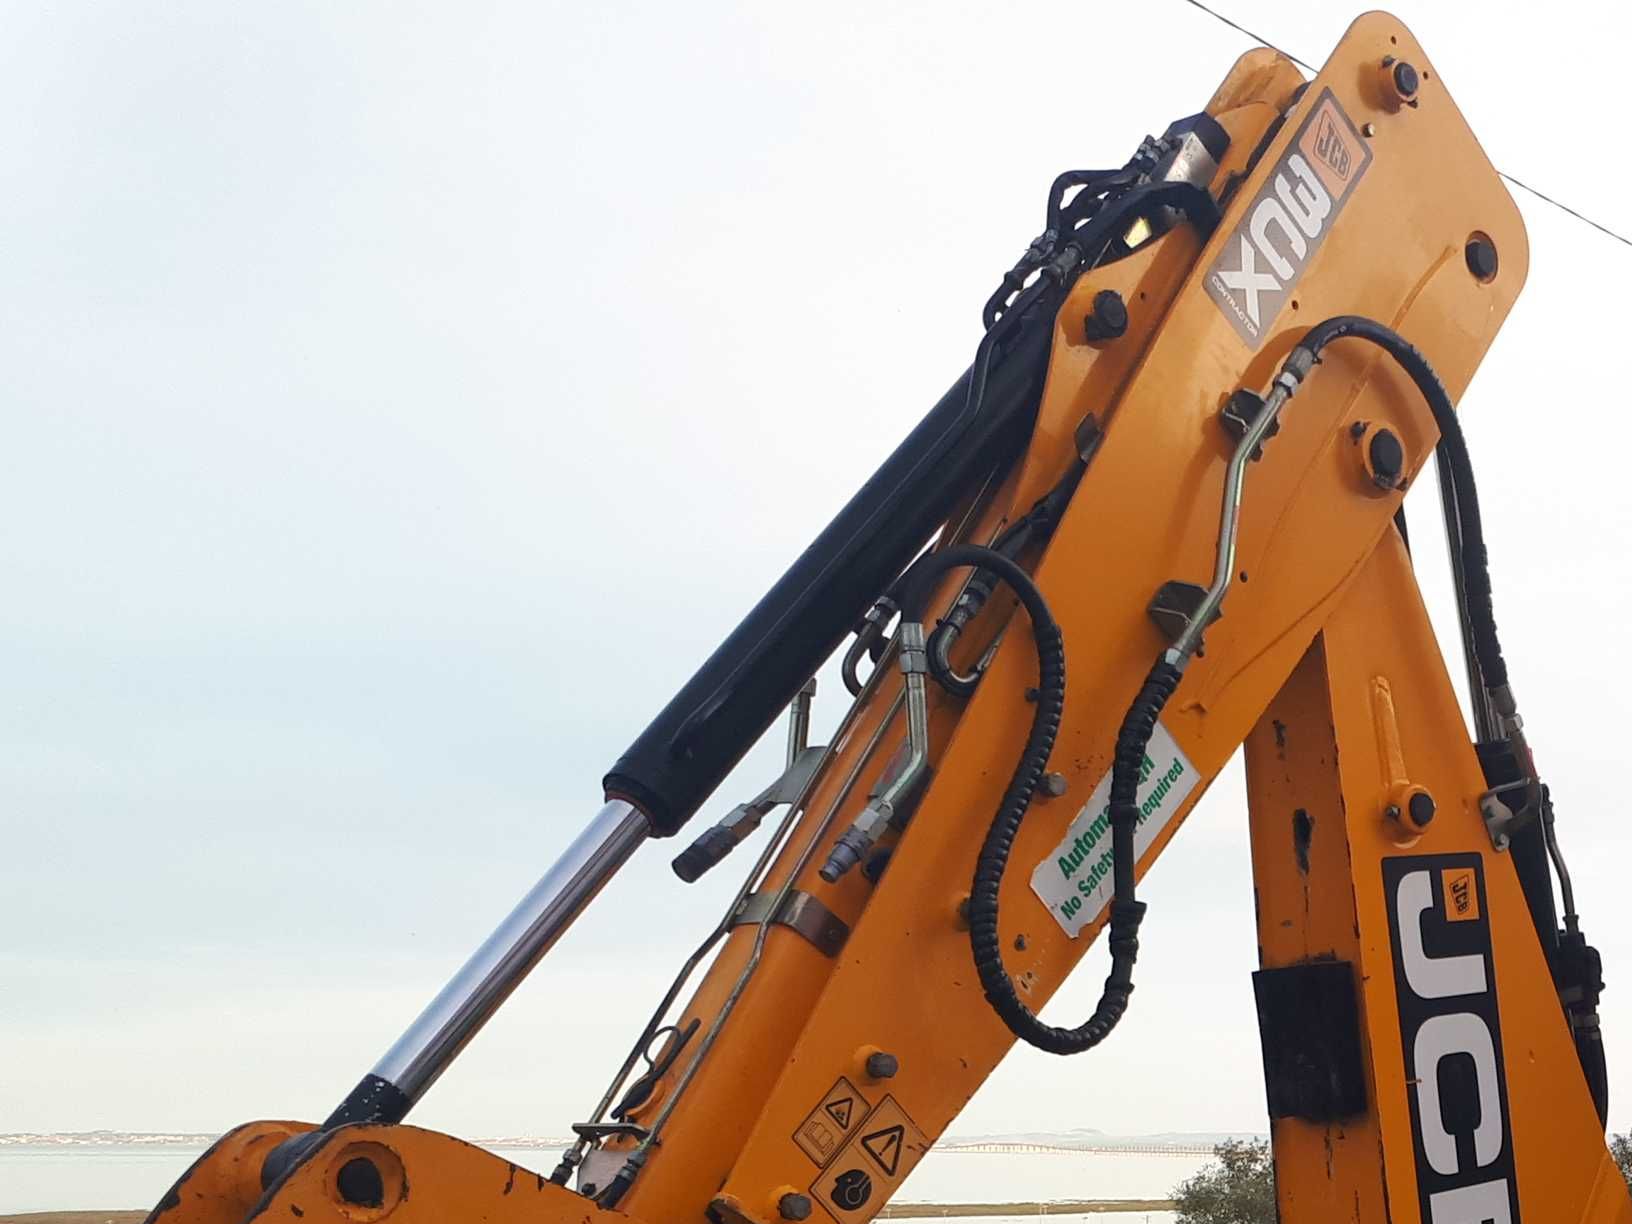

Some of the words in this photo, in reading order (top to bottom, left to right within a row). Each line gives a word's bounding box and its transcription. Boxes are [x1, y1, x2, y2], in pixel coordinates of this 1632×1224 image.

[1318, 121, 1350, 176] JCB
[1217, 154, 1332, 328] 3CX
[1211, 275, 1259, 338] CONTRACTOR
[1057, 805, 1112, 880] Automa
[1060, 896, 1082, 920] No
[1452, 878, 1471, 914] JCB
